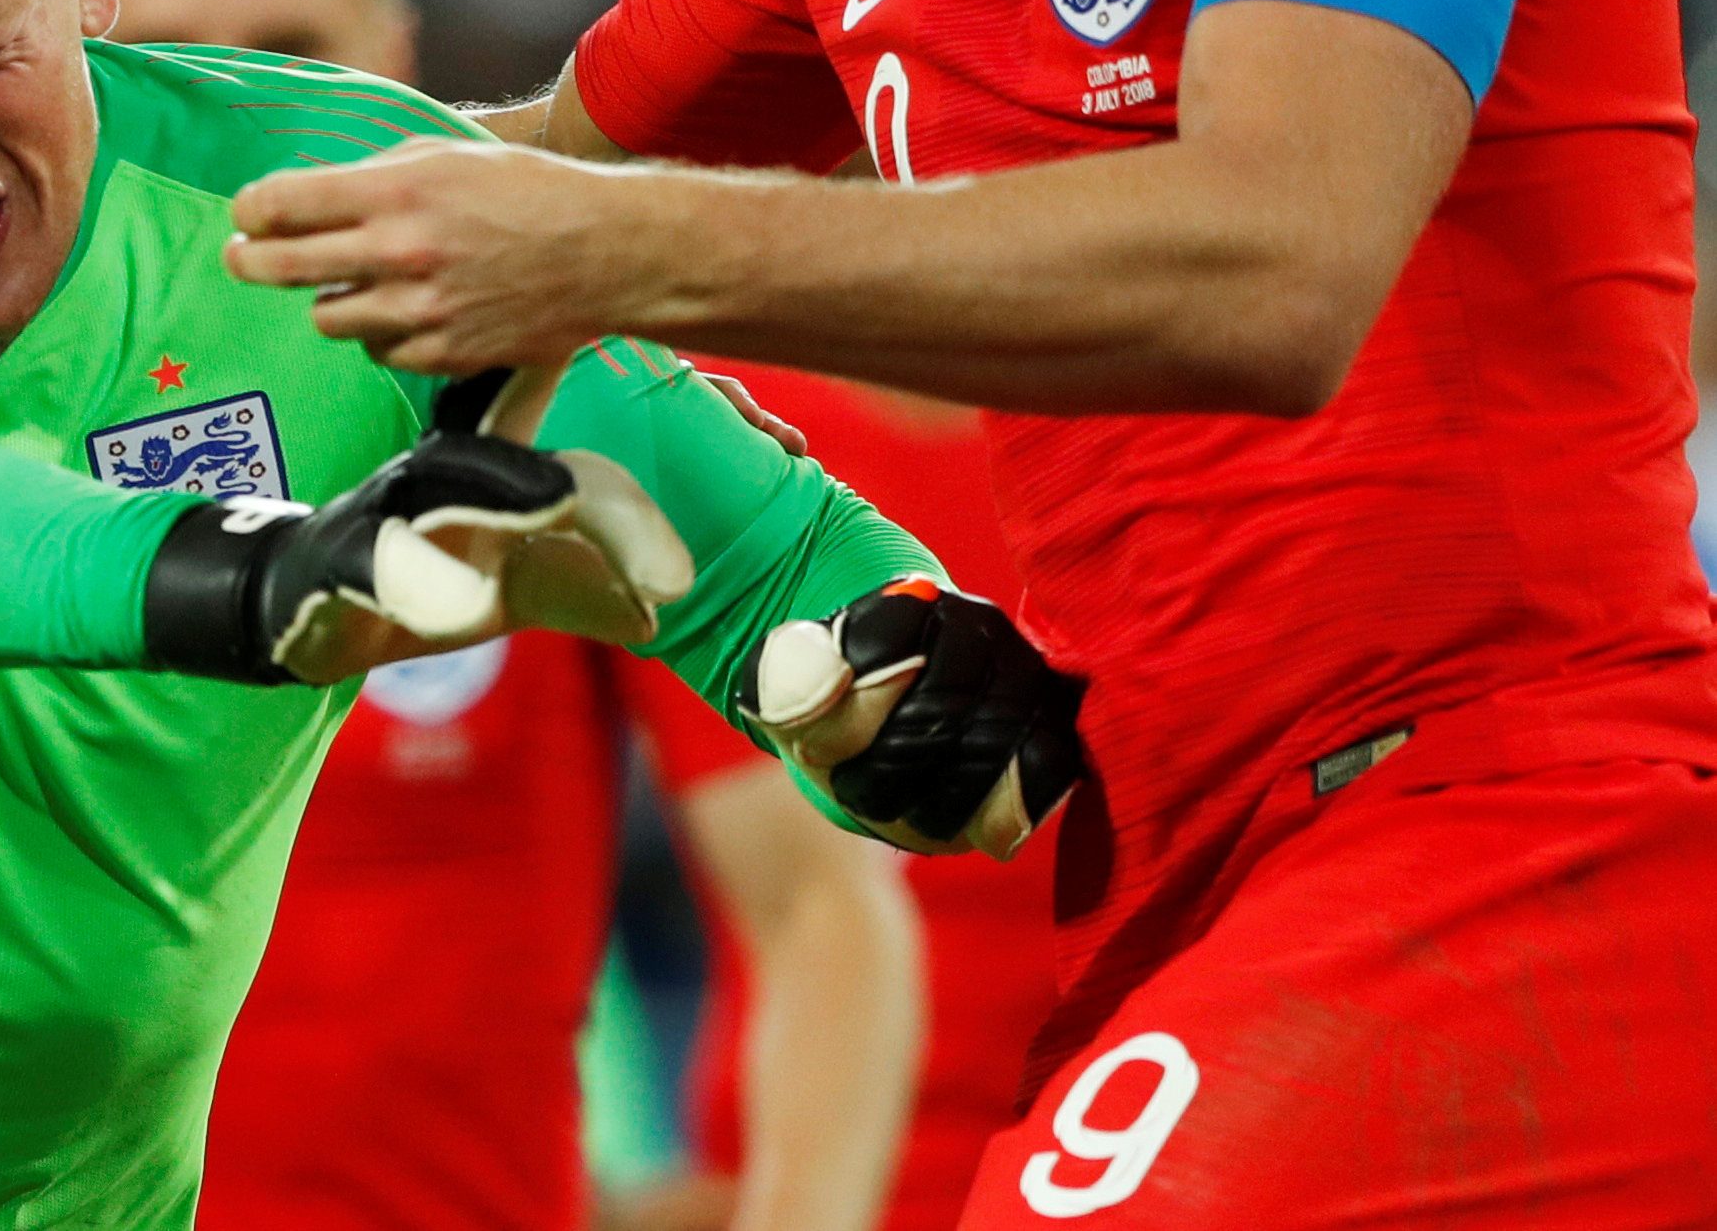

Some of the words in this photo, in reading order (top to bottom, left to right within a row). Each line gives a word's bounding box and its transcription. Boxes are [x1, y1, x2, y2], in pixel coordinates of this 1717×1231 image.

[1086, 53, 1152, 88] COLOMBIA
[1081, 91, 1093, 115] 3
[1094, 87, 1121, 114] JULY
[1121, 77, 1156, 106] 2018
[1019, 1030, 1200, 1219] 9
